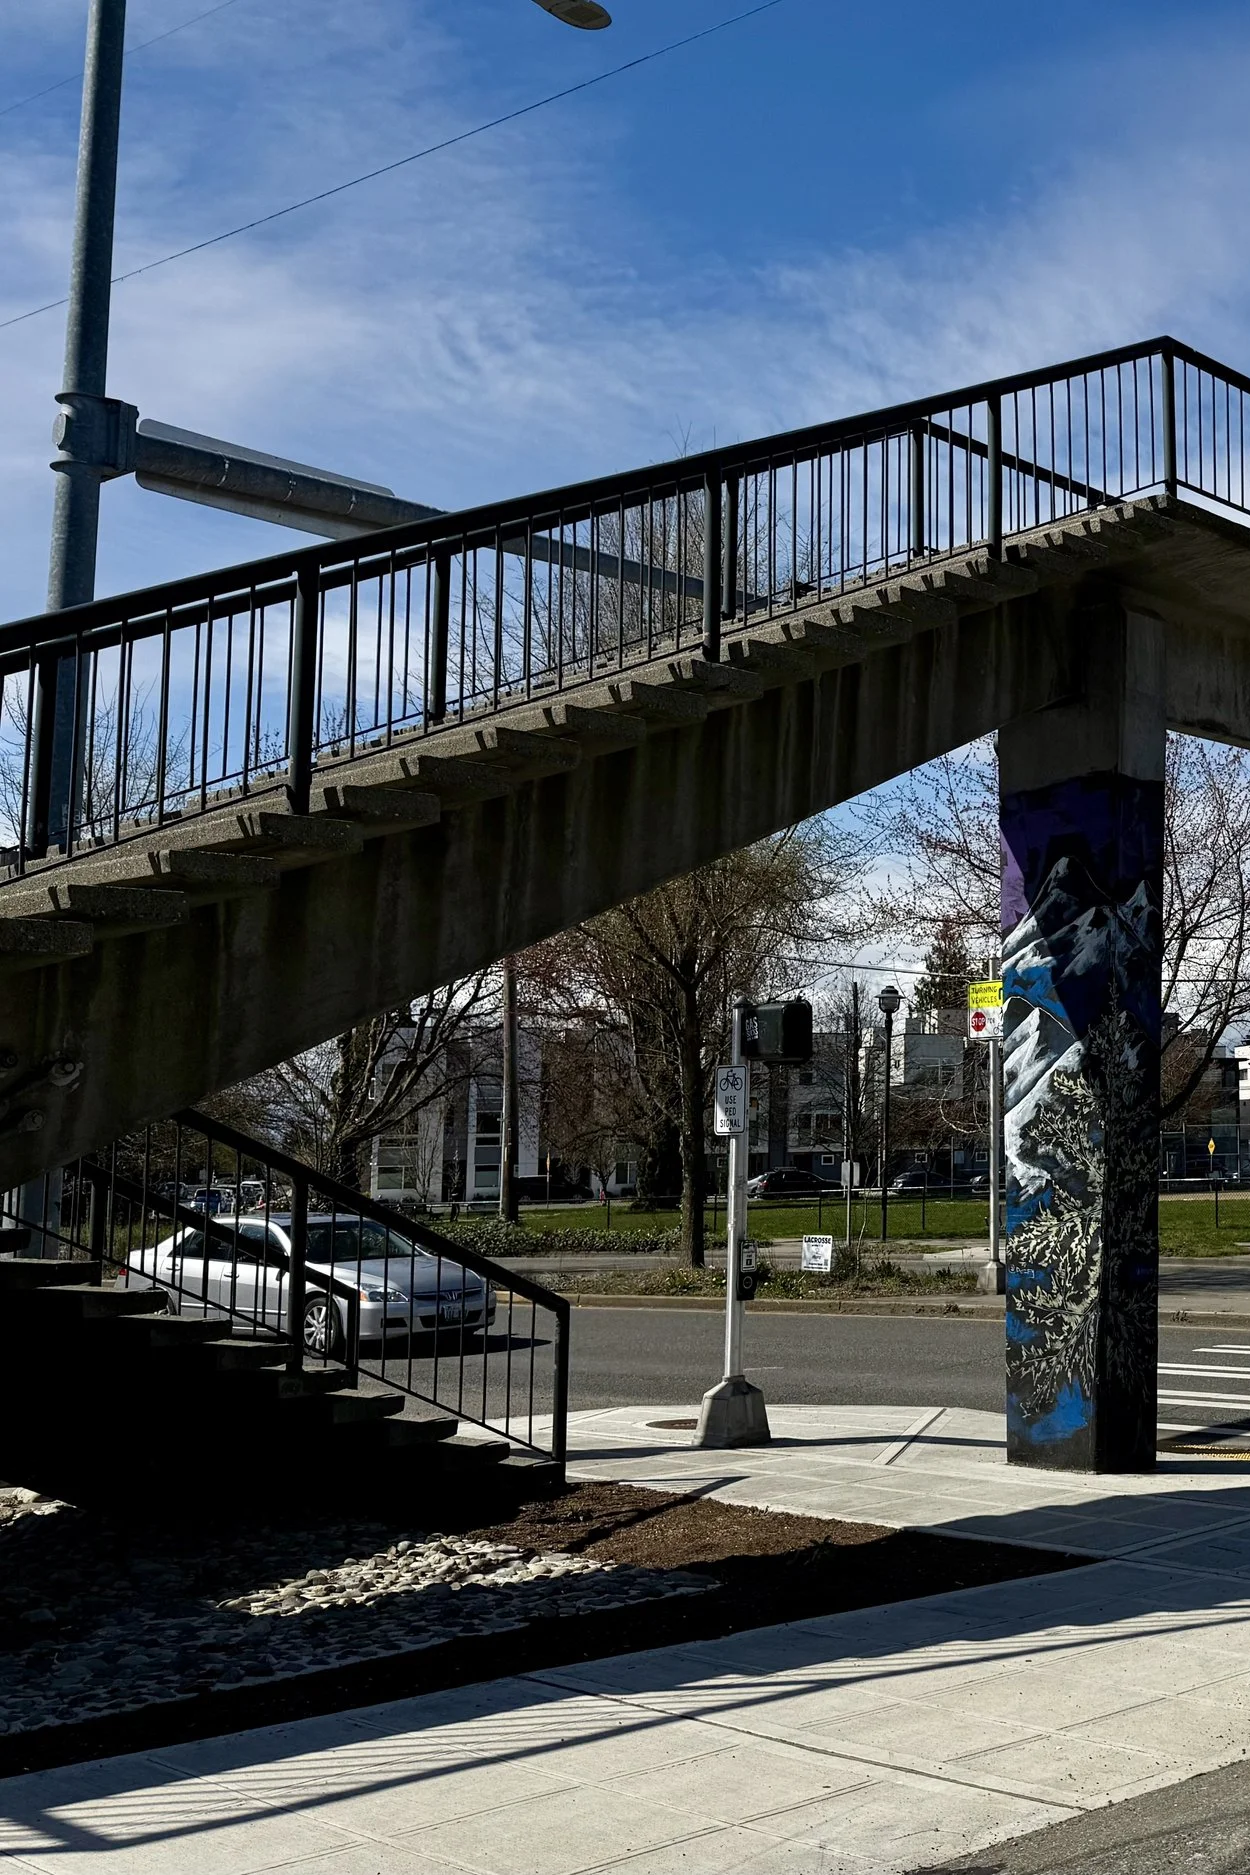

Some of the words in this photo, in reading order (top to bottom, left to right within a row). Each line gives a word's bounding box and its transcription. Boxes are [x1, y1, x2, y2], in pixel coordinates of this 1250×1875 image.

[971, 986, 997, 994] TURNING
[971, 996, 998, 1004] VEHICLES
[972, 1017, 986, 1026] STOP
[725, 1095, 737, 1104] USE
[725, 1107, 737, 1116] PED
[720, 1118, 741, 1128] SIGNAL
[804, 1236, 831, 1244] LACROSSE
